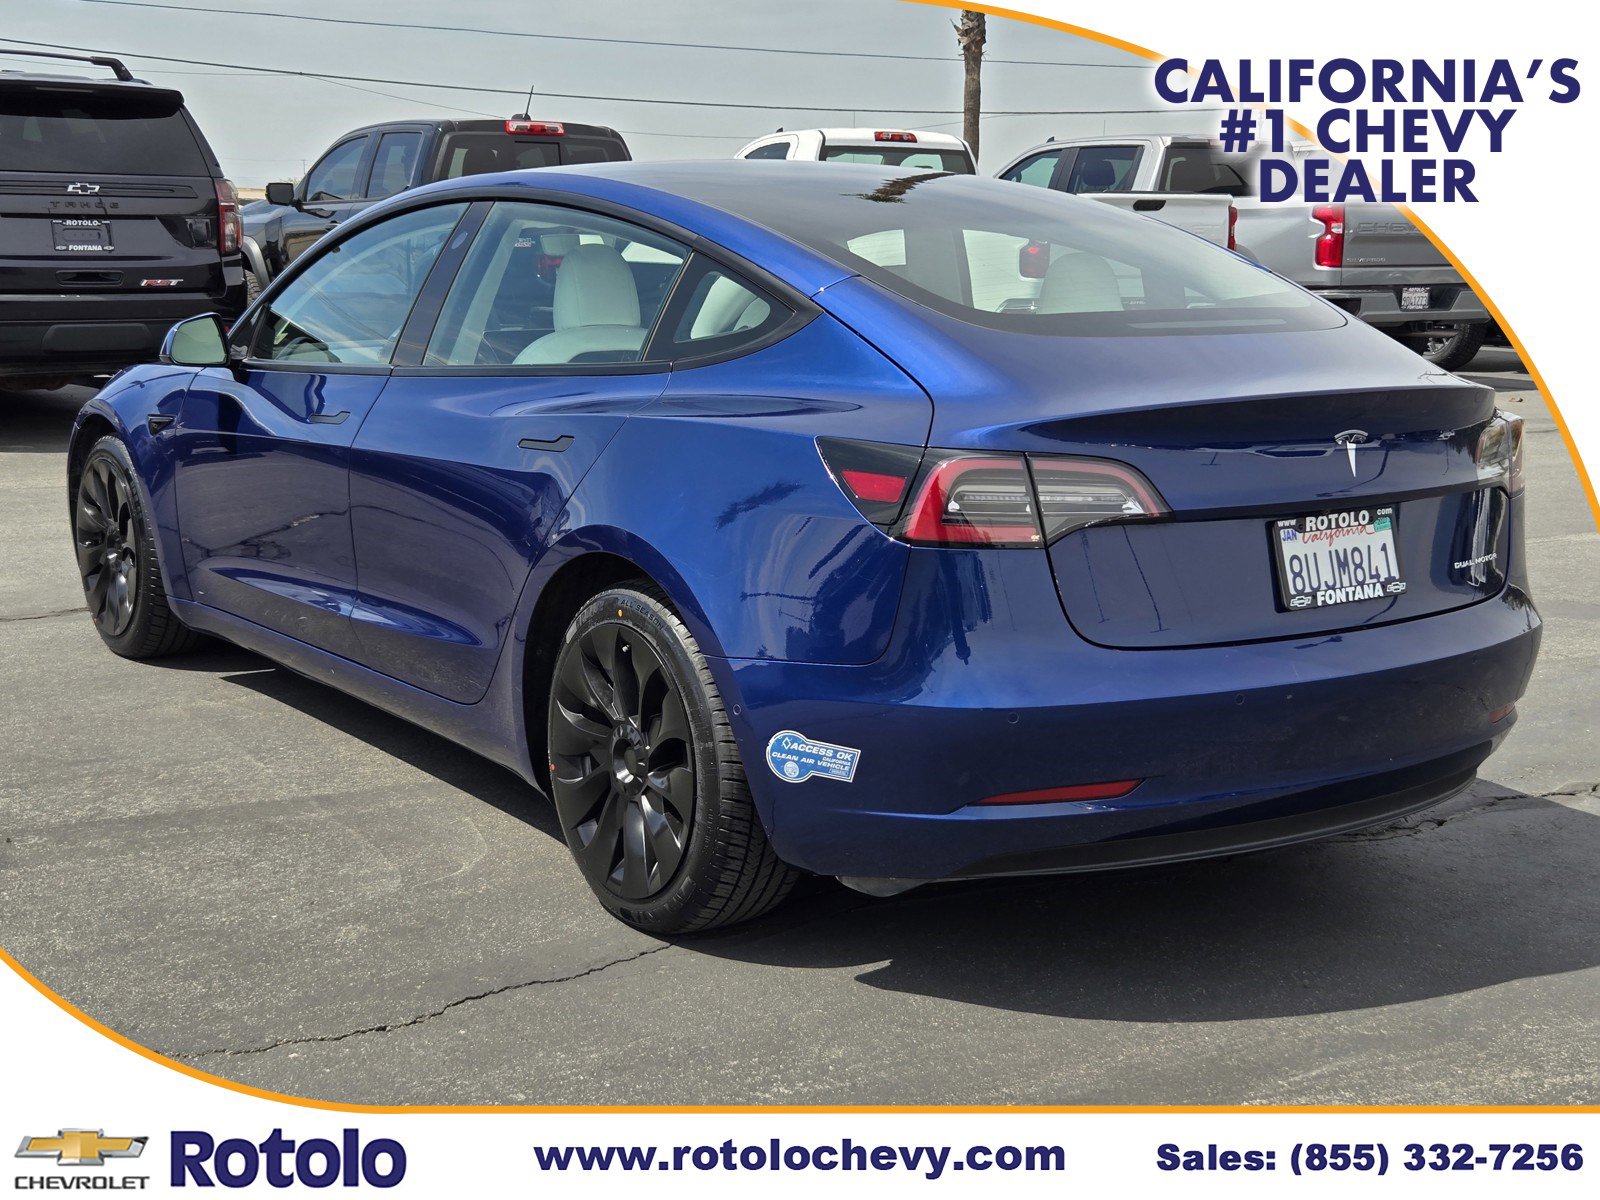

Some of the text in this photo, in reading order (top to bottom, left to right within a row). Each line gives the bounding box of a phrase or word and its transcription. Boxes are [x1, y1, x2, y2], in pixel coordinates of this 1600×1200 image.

[1305, 510, 1370, 532] ROTOLO
[1282, 525, 1375, 547] JAN California
[1289, 542, 1397, 595] 8UJM841
[1454, 560, 1475, 569] DUAL
[620, 599, 633, 608] ALL
[1316, 582, 1384, 606] FONTANA
[771, 751, 850, 771] CLEAN AIR VEHICLE
[790, 742, 854, 761] ACCESS OK
[822, 756, 851, 766] CALIFORNIA
